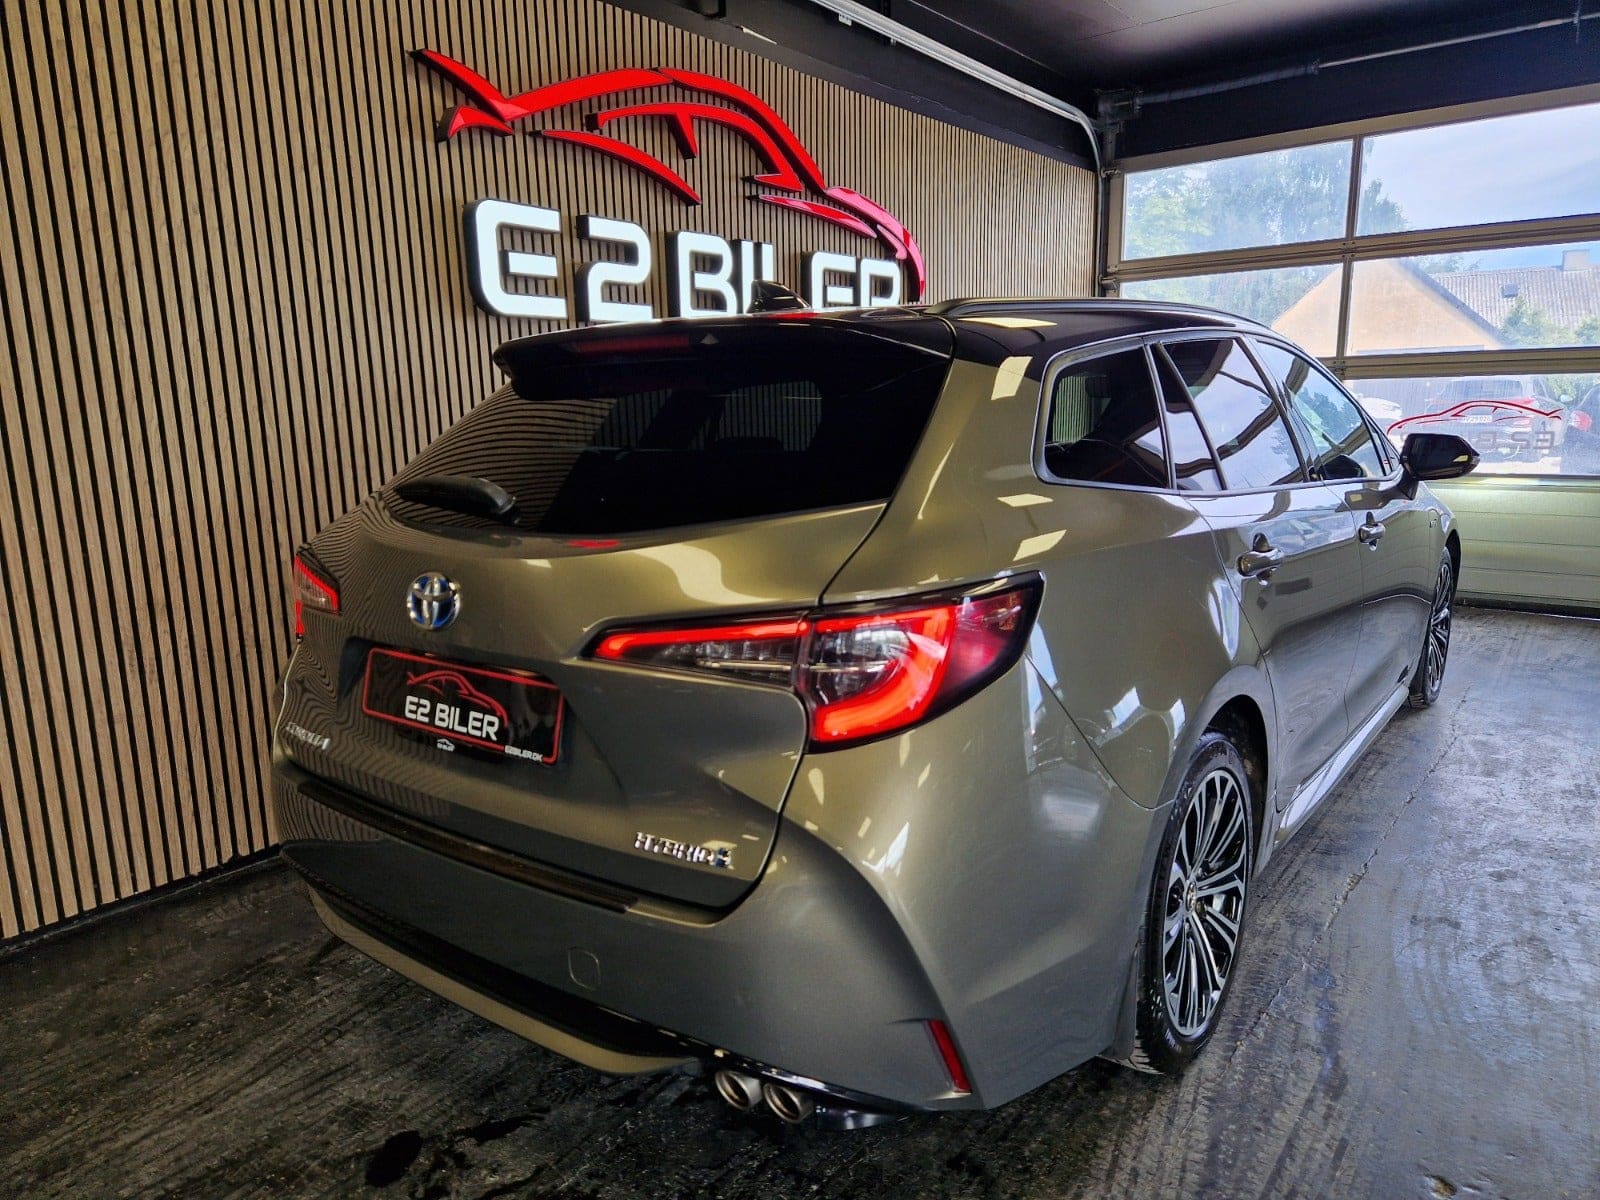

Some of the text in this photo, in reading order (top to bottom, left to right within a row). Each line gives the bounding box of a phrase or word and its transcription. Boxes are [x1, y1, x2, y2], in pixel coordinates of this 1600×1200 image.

[464, 198, 654, 322] E2
[404, 695, 500, 741] E2 BILER
